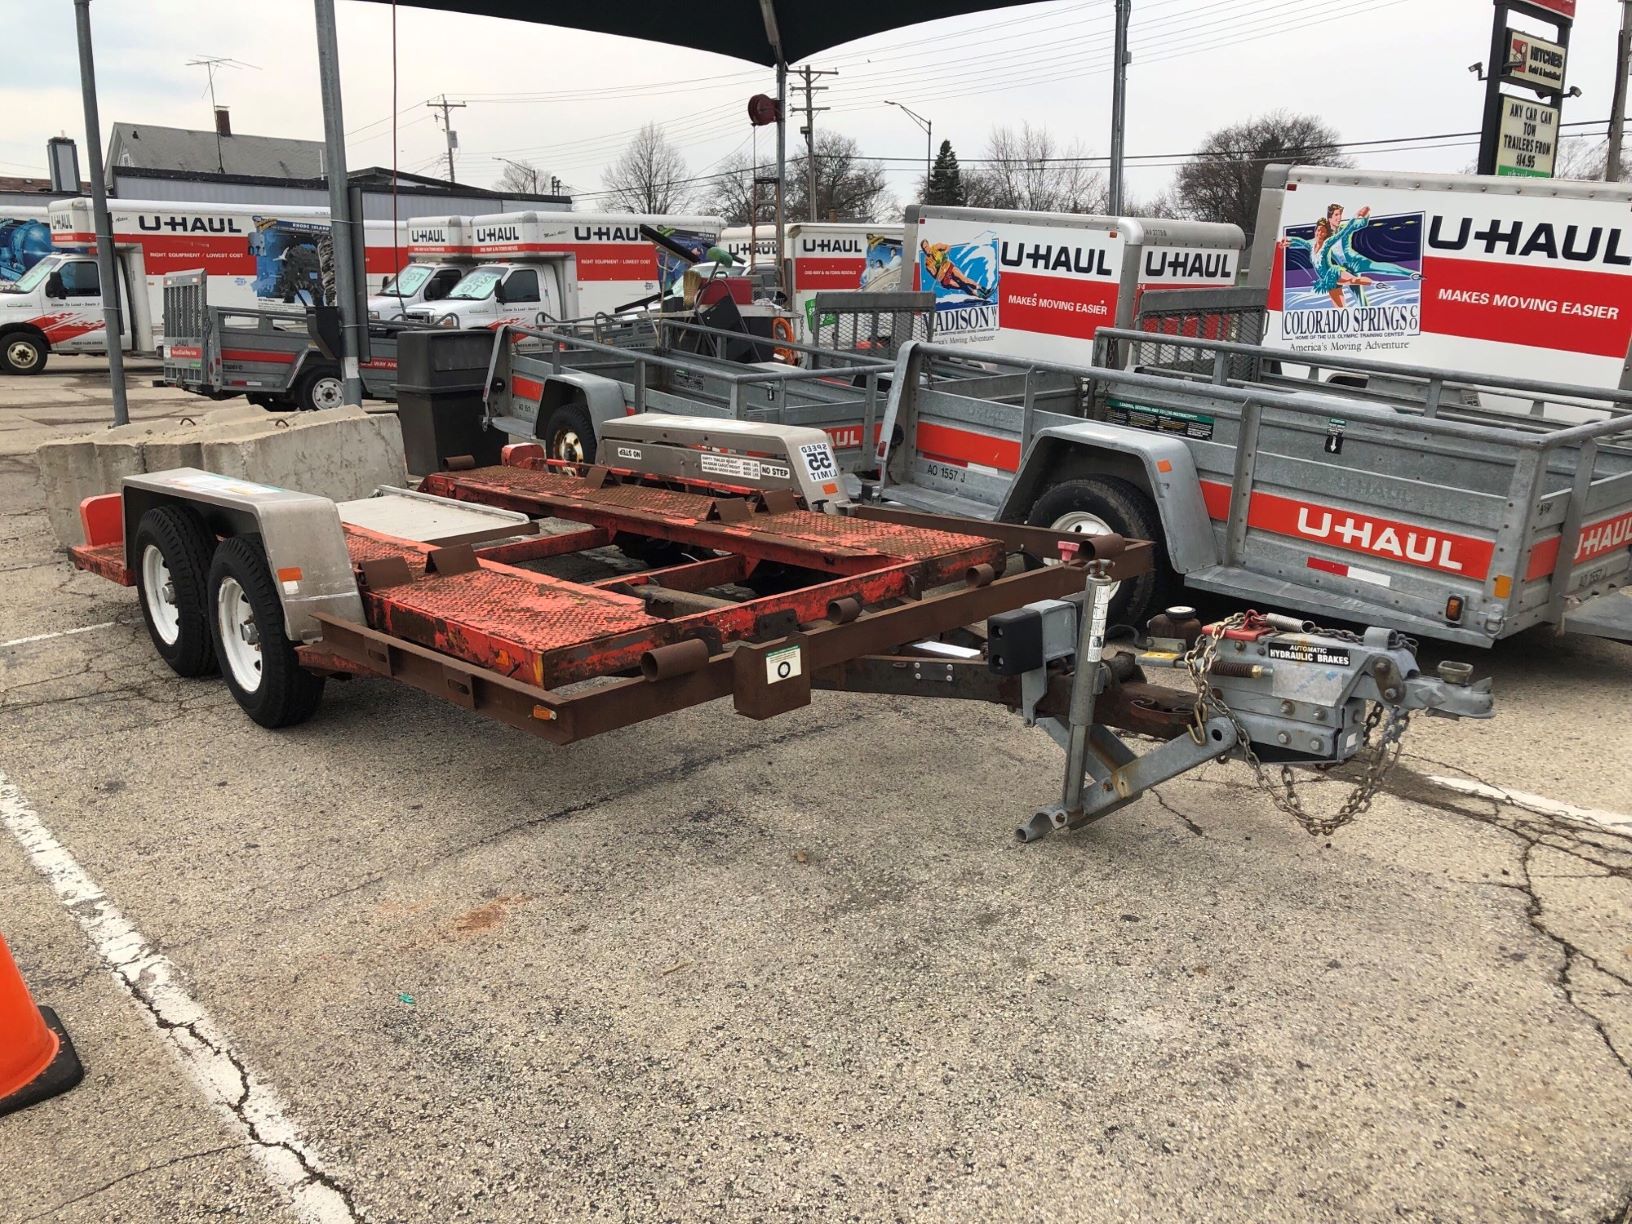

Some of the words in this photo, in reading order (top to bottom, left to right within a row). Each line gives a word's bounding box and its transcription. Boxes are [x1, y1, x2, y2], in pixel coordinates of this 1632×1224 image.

[1510, 103, 1523, 118] ANY
[1526, 108, 1537, 121] CAR
[1541, 112, 1552, 125] CAN
[1524, 123, 1536, 138] TOW
[1504, 134, 1534, 153] TRAILERS
[1535, 141, 1551, 155] FROM
[1516, 155, 1535, 169] $14.95
[139, 216, 242, 233] U-HAUL
[413, 230, 445, 243] U-HAUL
[477, 226, 520, 242] U-HAUL
[1428, 216, 1632, 265] U-HAUL
[803, 239, 862, 252] U-HAUL
[1001, 242, 1112, 276] U-HAUL
[1145, 251, 1231, 278] U-HAUL
[1008, 295, 1037, 307] MAKES
[1039, 298, 1075, 311] MOVING
[1076, 302, 1108, 315] EASIER
[1438, 288, 1489, 305] MAKES
[1492, 294, 1558, 314] MOVING
[1561, 302, 1619, 320] EASIER
[1284, 309, 1350, 335] COLORADO
[1353, 306, 1408, 333] SPRINGS
[970, 335, 995, 343] Adventure
[1290, 343, 1328, 352] America's
[1330, 340, 1362, 352] Moving
[1365, 340, 1410, 350] Adventure
[761, 466, 772, 476] NO
[772, 468, 788, 478] STEP
[941, 468, 958, 481] 1557
[1296, 506, 1462, 571] U-HAUL
[1270, 649, 1314, 662] HYDRAULIC
[1317, 654, 1349, 666] BRAKES
[1290, 645, 1328, 654] AUTOMATIC
